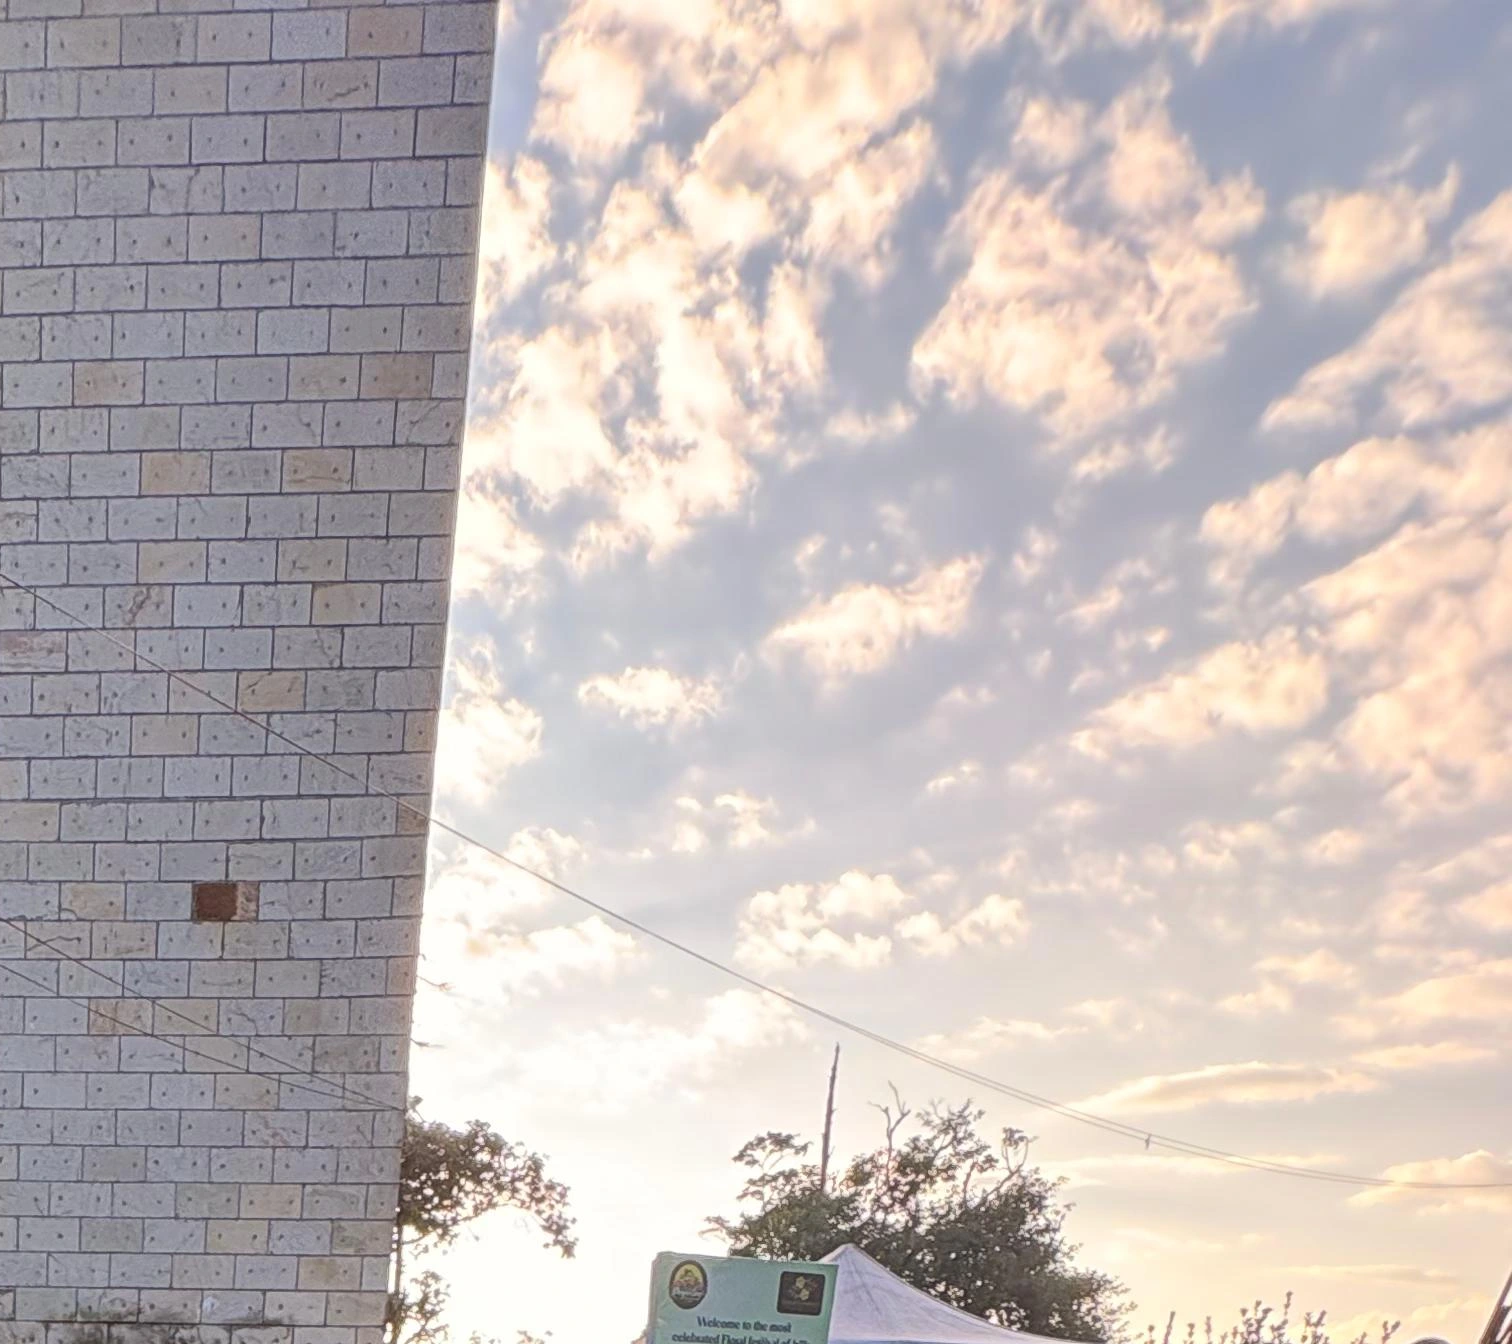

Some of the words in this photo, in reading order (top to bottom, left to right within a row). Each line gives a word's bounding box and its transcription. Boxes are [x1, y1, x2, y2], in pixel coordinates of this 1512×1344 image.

[697, 1316, 740, 1331] Welcome
[743, 1319, 752, 1331] to
[754, 1320, 767, 1332] the
[769, 1321, 791, 1333] most
